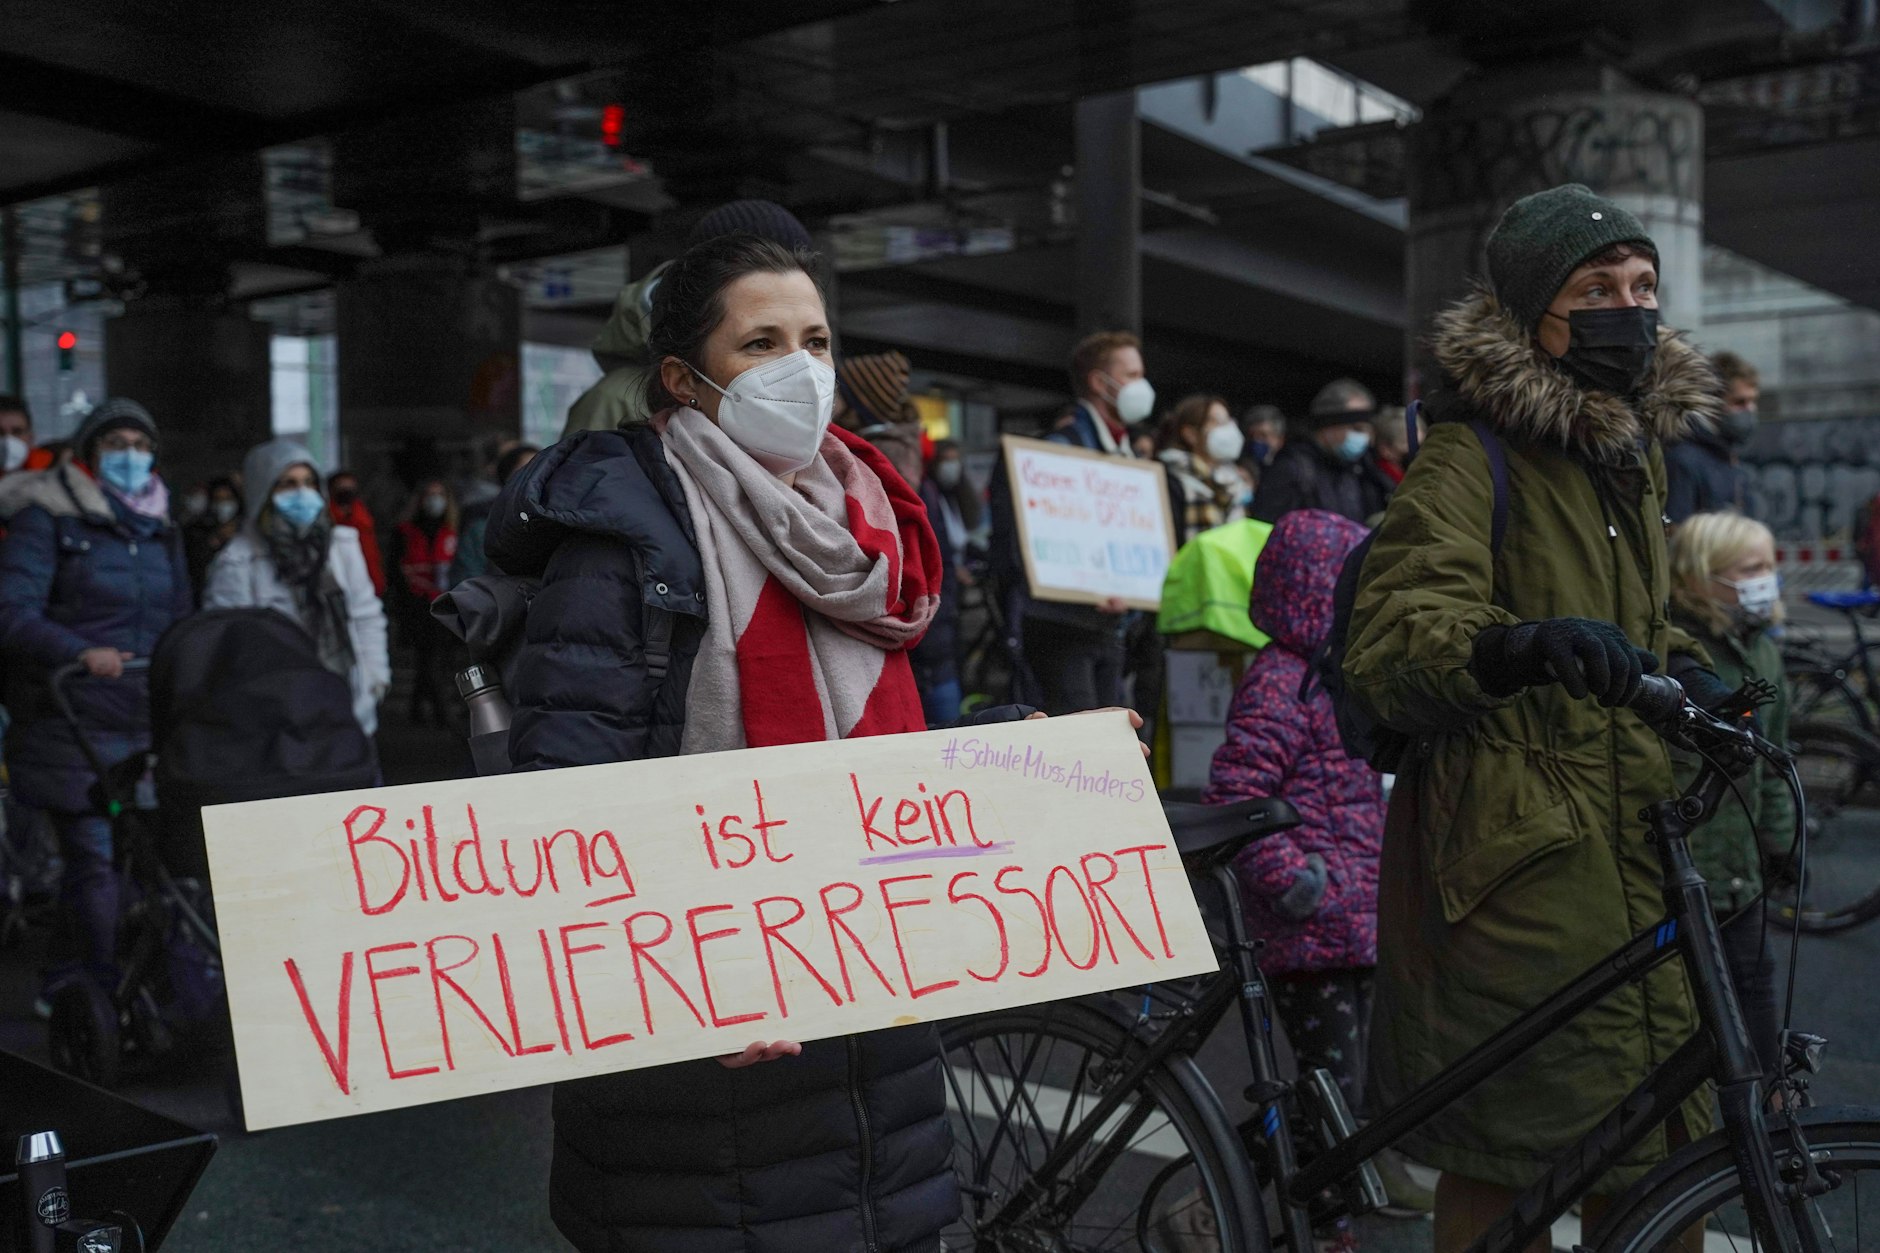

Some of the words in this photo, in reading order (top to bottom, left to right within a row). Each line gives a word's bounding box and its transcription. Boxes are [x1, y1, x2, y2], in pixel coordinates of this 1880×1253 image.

[940, 737, 1145, 803] #SchuleMussAnders
[343, 804, 636, 916] Bildung
[695, 778, 795, 871] ist
[850, 772, 1000, 852] kein
[283, 843, 1175, 1096] VERLIERERRESSORT
